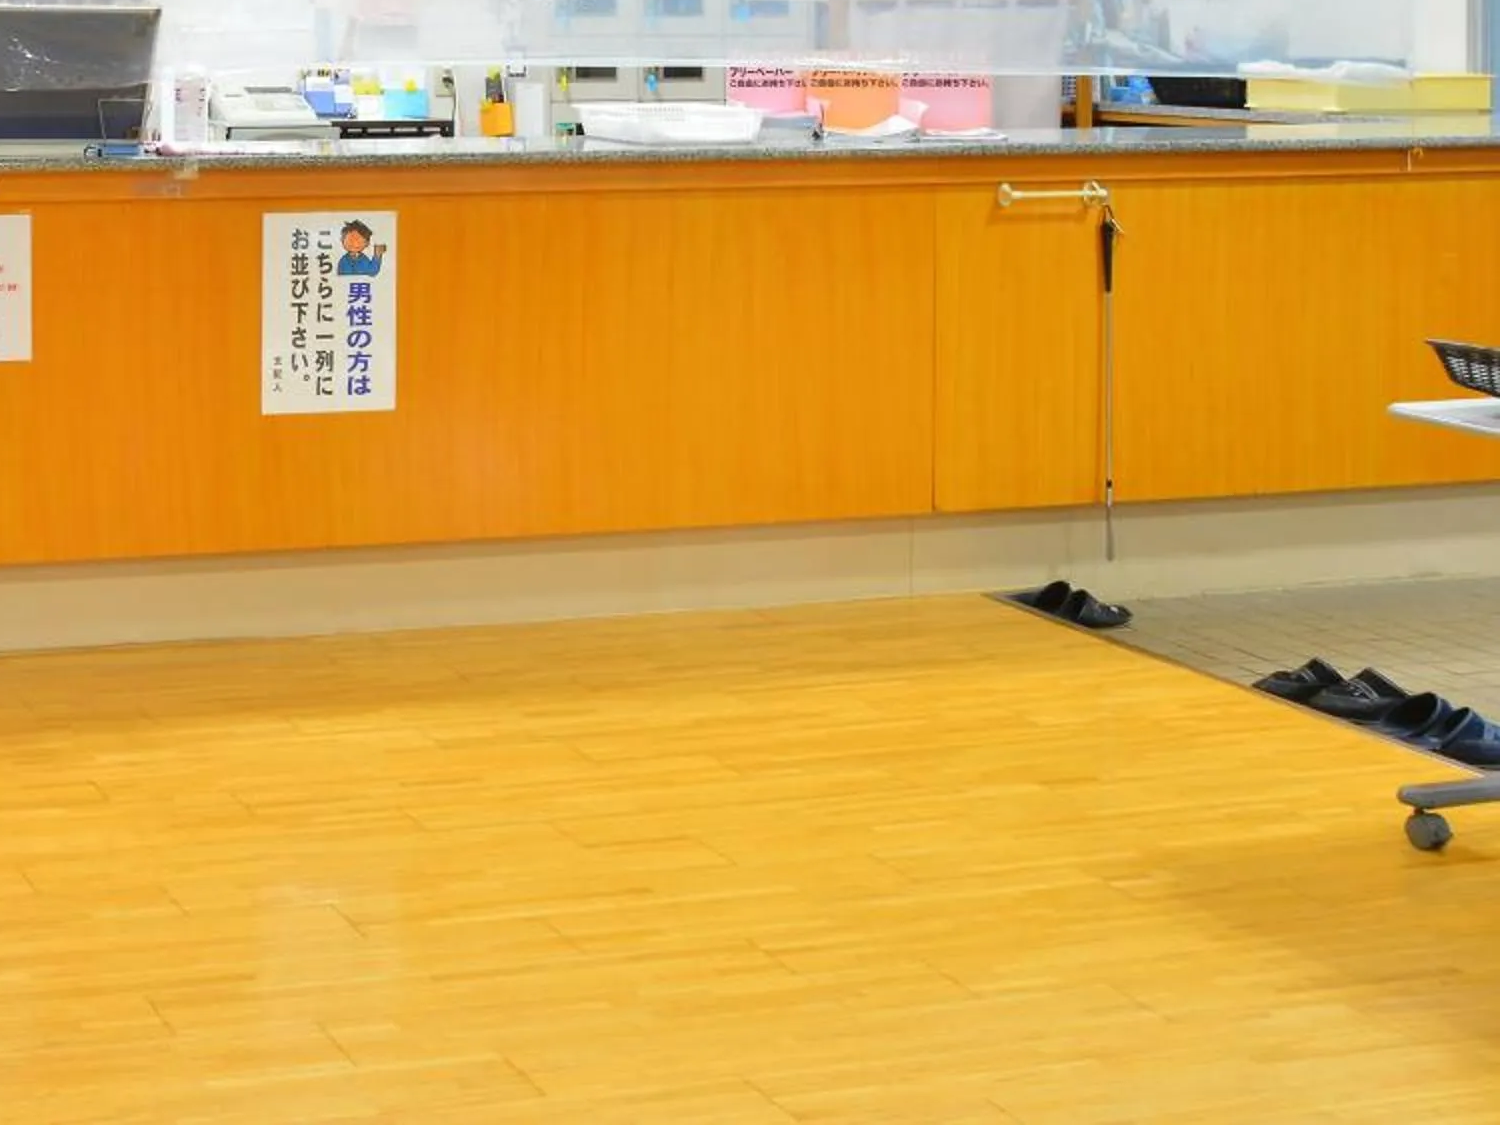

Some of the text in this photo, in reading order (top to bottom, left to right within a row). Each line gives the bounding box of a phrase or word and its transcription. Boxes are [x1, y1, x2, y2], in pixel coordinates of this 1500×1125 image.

[291, 228, 310, 382] お並び下さい。
[316, 230, 335, 396] こちらに一列に
[346, 282, 373, 396] 男性の方は
